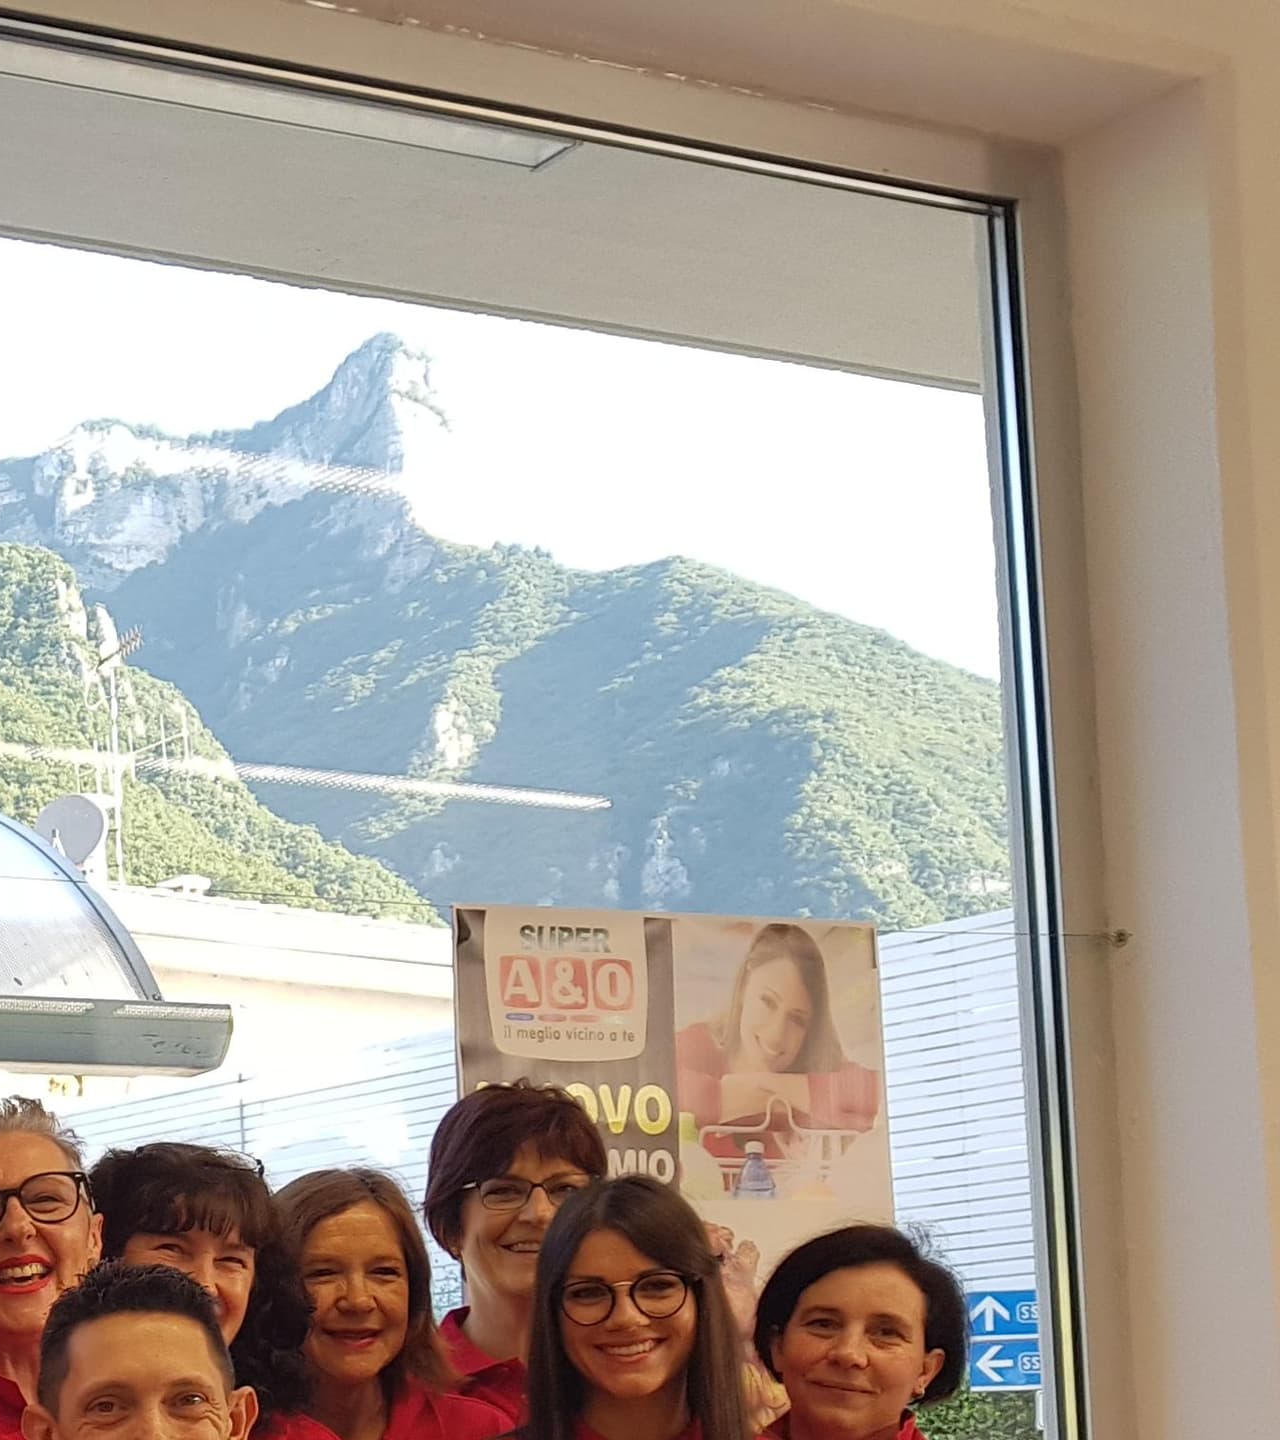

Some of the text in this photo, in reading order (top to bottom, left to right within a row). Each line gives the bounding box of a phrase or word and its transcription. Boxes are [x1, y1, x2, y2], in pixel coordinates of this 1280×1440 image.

[519, 924, 611, 953] SUPER
[502, 958, 633, 1008] A&O
[503, 1025, 636, 1043] il meglio vicino a te
